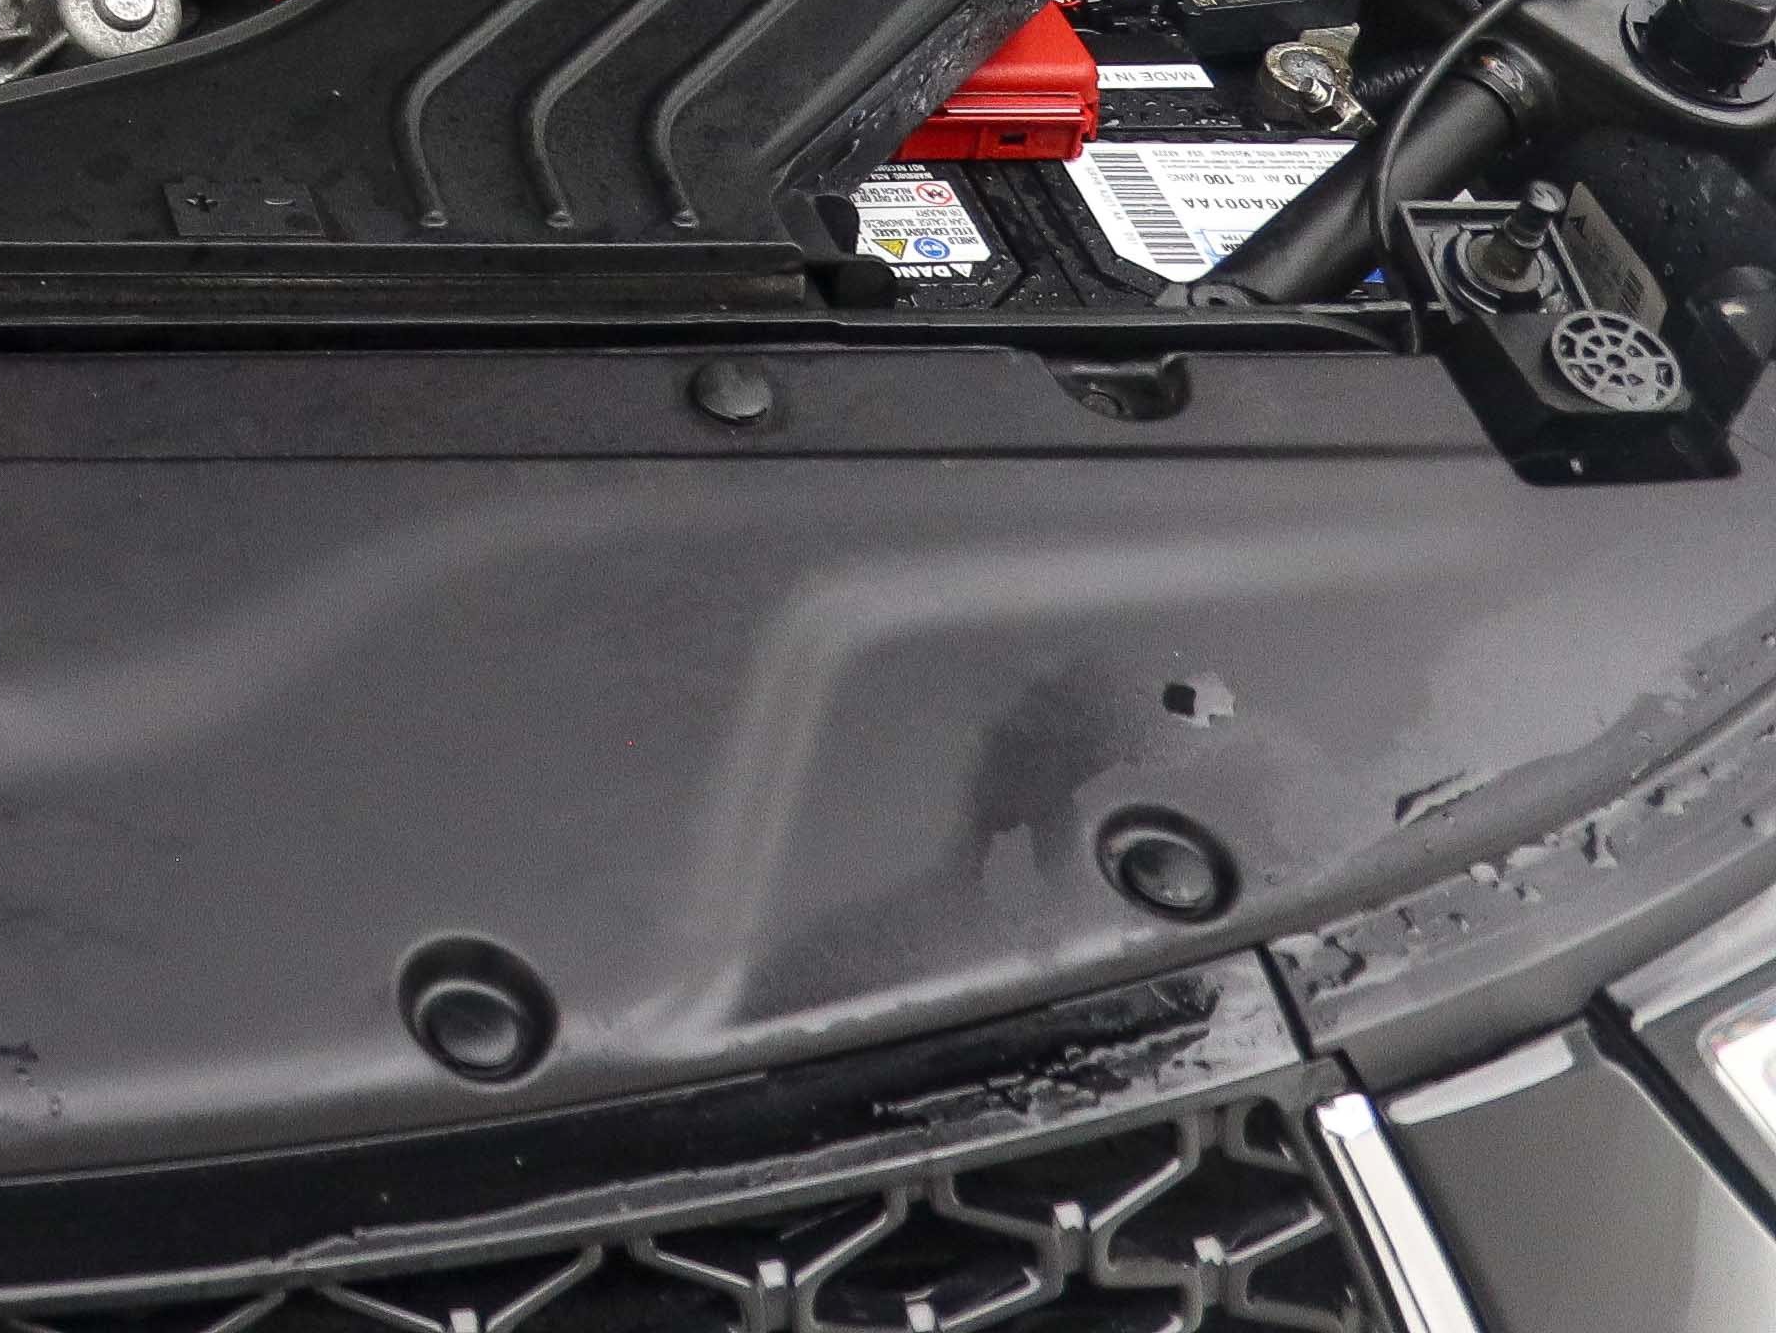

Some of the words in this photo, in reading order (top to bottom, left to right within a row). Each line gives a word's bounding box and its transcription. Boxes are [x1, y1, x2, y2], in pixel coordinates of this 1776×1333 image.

[1115, 73, 1136, 82] IN
[1138, 71, 1197, 82] MADE
[1204, 174, 1235, 185] 100
[1285, 174, 1307, 185] 70
